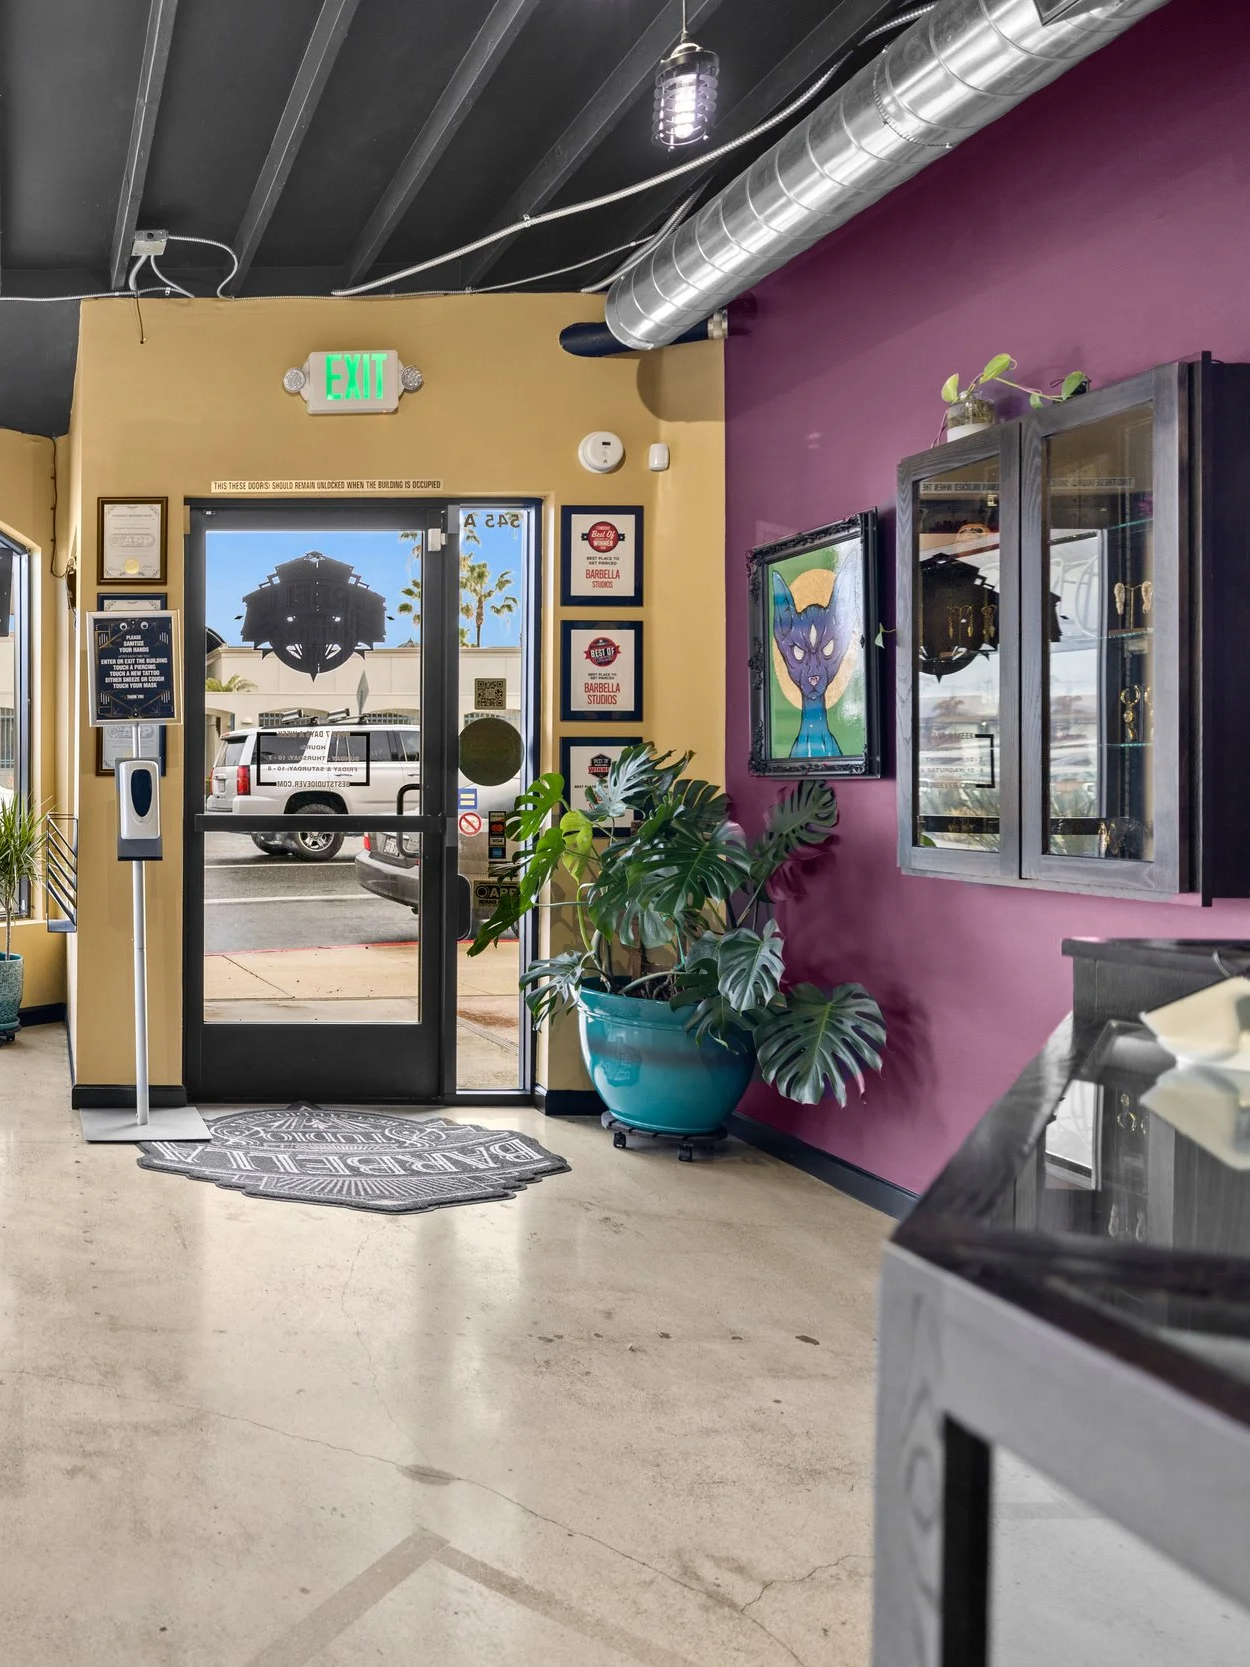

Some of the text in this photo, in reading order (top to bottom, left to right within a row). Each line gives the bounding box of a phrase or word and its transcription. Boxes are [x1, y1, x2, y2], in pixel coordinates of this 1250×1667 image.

[326, 353, 387, 400] EXIT
[214, 481, 227, 490] THIS
[230, 481, 246, 490] THESE
[272, 481, 293, 490] SHOULD
[295, 481, 316, 490] REMAIN
[317, 481, 345, 490] UNLOCKED
[347, 481, 364, 489] WHEN
[367, 481, 376, 489] THE
[378, 481, 403, 489] BUILDING
[405, 481, 410, 489] IS
[413, 480, 441, 489] OCCUPIED
[591, 530, 615, 540] Best Of
[586, 569, 620, 579] BARBELLA
[591, 647, 615, 658] BEST OF
[584, 683, 620, 693] BARBELLA
[587, 695, 617, 705] STUDIOS
[151, 1138, 545, 1175] BARBELLA
